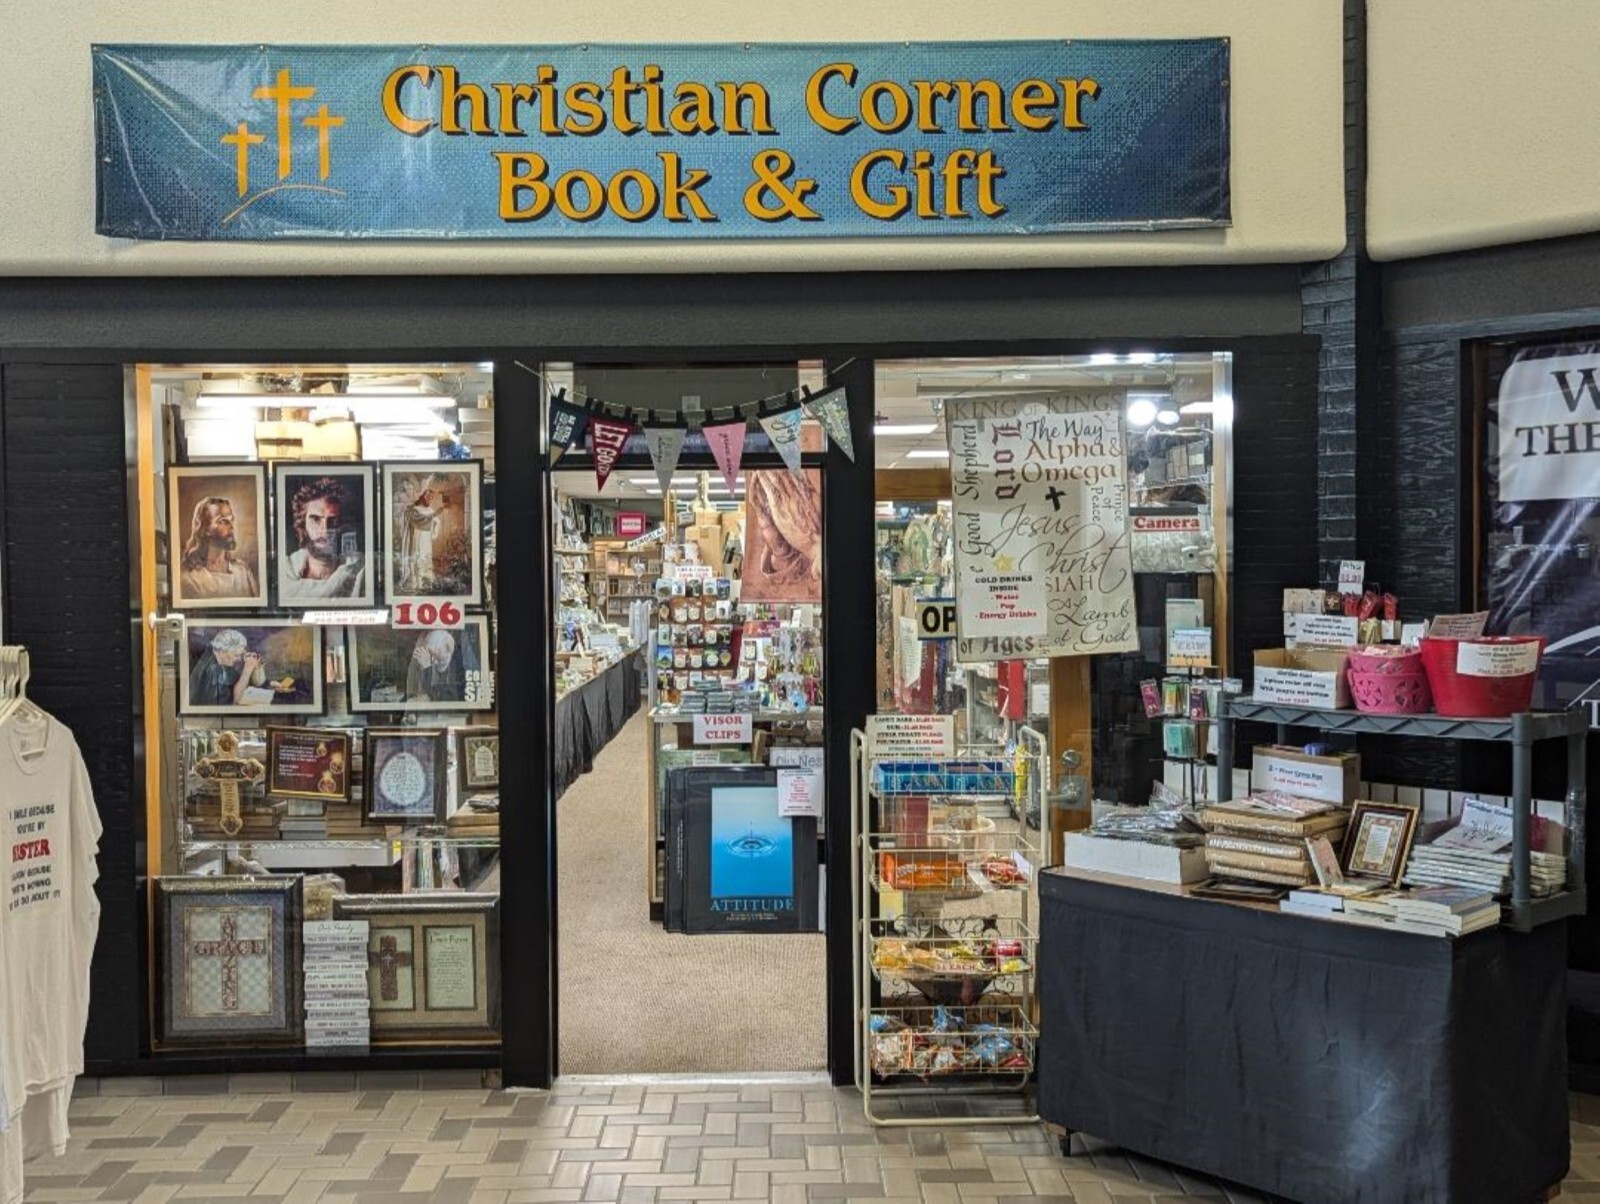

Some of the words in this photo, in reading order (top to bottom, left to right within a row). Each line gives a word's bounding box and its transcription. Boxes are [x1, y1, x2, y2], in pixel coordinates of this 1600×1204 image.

[381, 64, 777, 136] Christian
[805, 63, 1101, 134] Corner
[492, 151, 718, 222] Book
[743, 149, 824, 221] &
[850, 149, 1007, 220] Gift
[955, 400, 1017, 420] KING
[1047, 391, 1124, 414] KINGS
[595, 423, 628, 448] LET
[1026, 417, 1061, 440] The
[1064, 418, 1103, 445] Way
[953, 424, 988, 500] Shepherd
[1025, 438, 1106, 464] Alpha
[1108, 438, 1125, 458] &
[1021, 461, 1117, 485] Omega
[1091, 486, 1104, 522] Peace
[958, 512, 983, 556] Good
[978, 503, 1081, 558] Jesus
[1134, 517, 1200, 529] Camera
[1019, 523, 1131, 594] Christ
[975, 576, 998, 584] COLD
[1000, 575, 1033, 584] DRINKS
[395, 602, 461, 625] 106
[1073, 620, 1132, 652] God
[703, 715, 743, 724] VISOR
[706, 730, 741, 739] CLIPS
[710, 899, 794, 912] ATTITUDE
